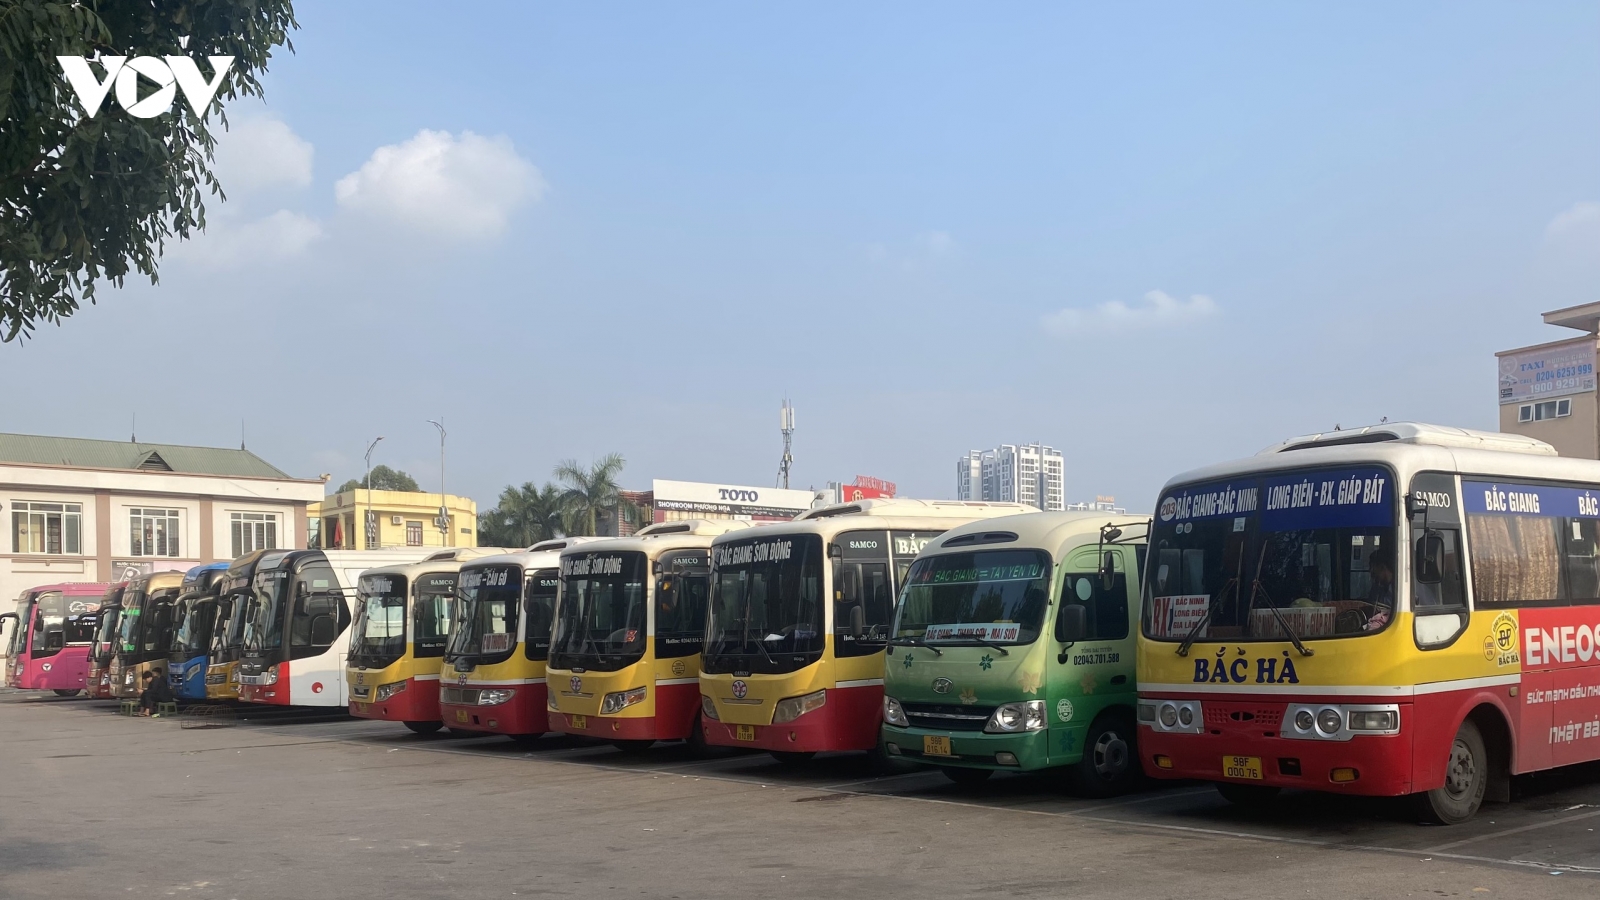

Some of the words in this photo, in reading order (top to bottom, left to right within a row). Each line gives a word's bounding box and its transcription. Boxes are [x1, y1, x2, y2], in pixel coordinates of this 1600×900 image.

[1520, 361, 1544, 371] TAXI
[1536, 371, 1555, 382] 0204
[1557, 368, 1576, 378] 6253
[1577, 364, 1592, 374] 999
[1530, 382, 1553, 394] 1900
[1556, 379, 1580, 390] 9291
[718, 488, 759, 503] TOTO
[1266, 484, 1291, 511] LONG
[1291, 479, 1315, 507] BIÊN
[1338, 475, 1362, 505] GIÁP
[1363, 474, 1385, 504] BÁT
[1415, 491, 1451, 508] SAMCO
[1484, 485, 1507, 513] BẮC
[1508, 492, 1541, 514] GIANG
[658, 501, 693, 509] SHOWROOM
[1235, 487, 1258, 513] NINH
[1161, 502, 1176, 516] 203
[850, 540, 878, 549] SAMCO
[732, 546, 753, 565] GIANG
[952, 568, 978, 582] GIANG
[1189, 597, 1205, 606] NINH
[1174, 609, 1190, 617] LONG
[1172, 621, 1184, 629] GIA
[990, 628, 1003, 640] MAI
[1073, 653, 1120, 666] 02043.701.588
[1193, 647, 1248, 683] BẮC
[1256, 651, 1300, 684] HÀ
[1233, 756, 1249, 767] 98F
[1227, 767, 1258, 778] 000.76
